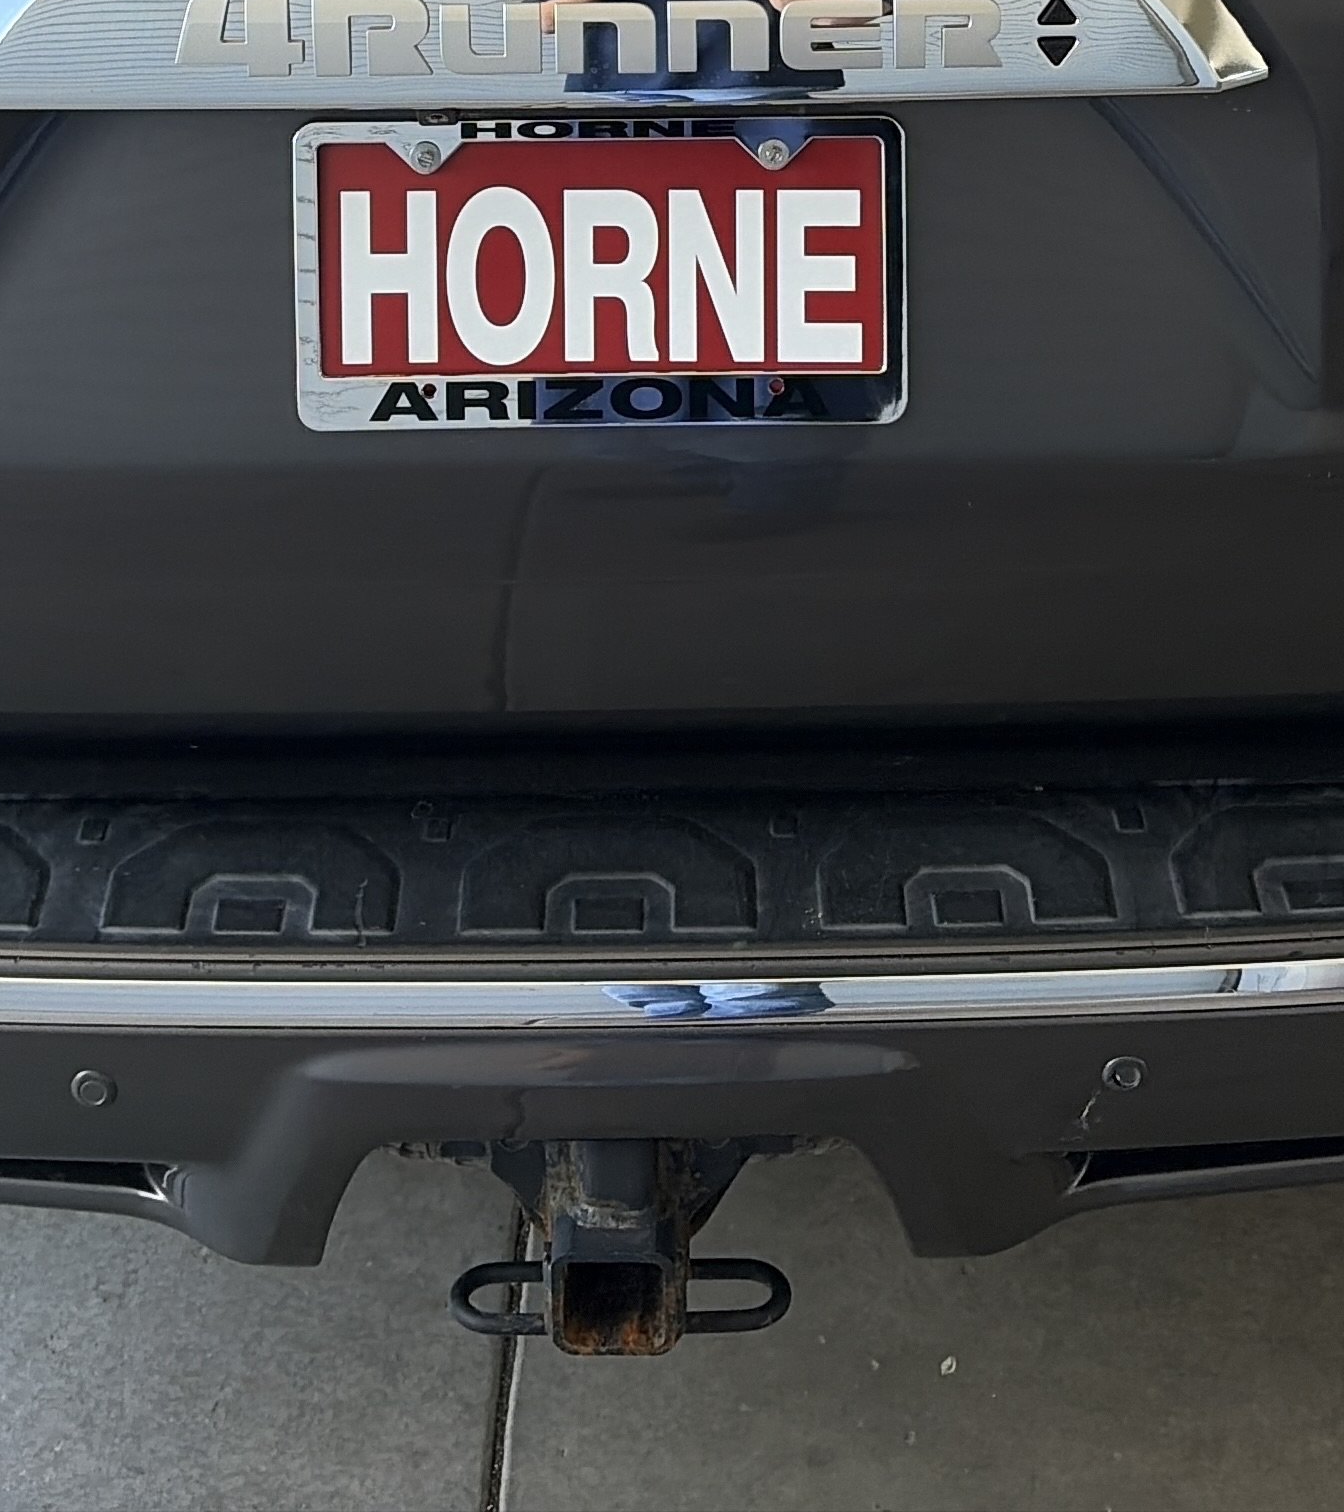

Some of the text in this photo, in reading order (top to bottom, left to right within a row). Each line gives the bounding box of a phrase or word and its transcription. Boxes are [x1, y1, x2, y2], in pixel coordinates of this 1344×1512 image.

[460, 120, 735, 139] HORNE
[340, 186, 862, 365] HORNE
[369, 378, 828, 422] ARIZONA
